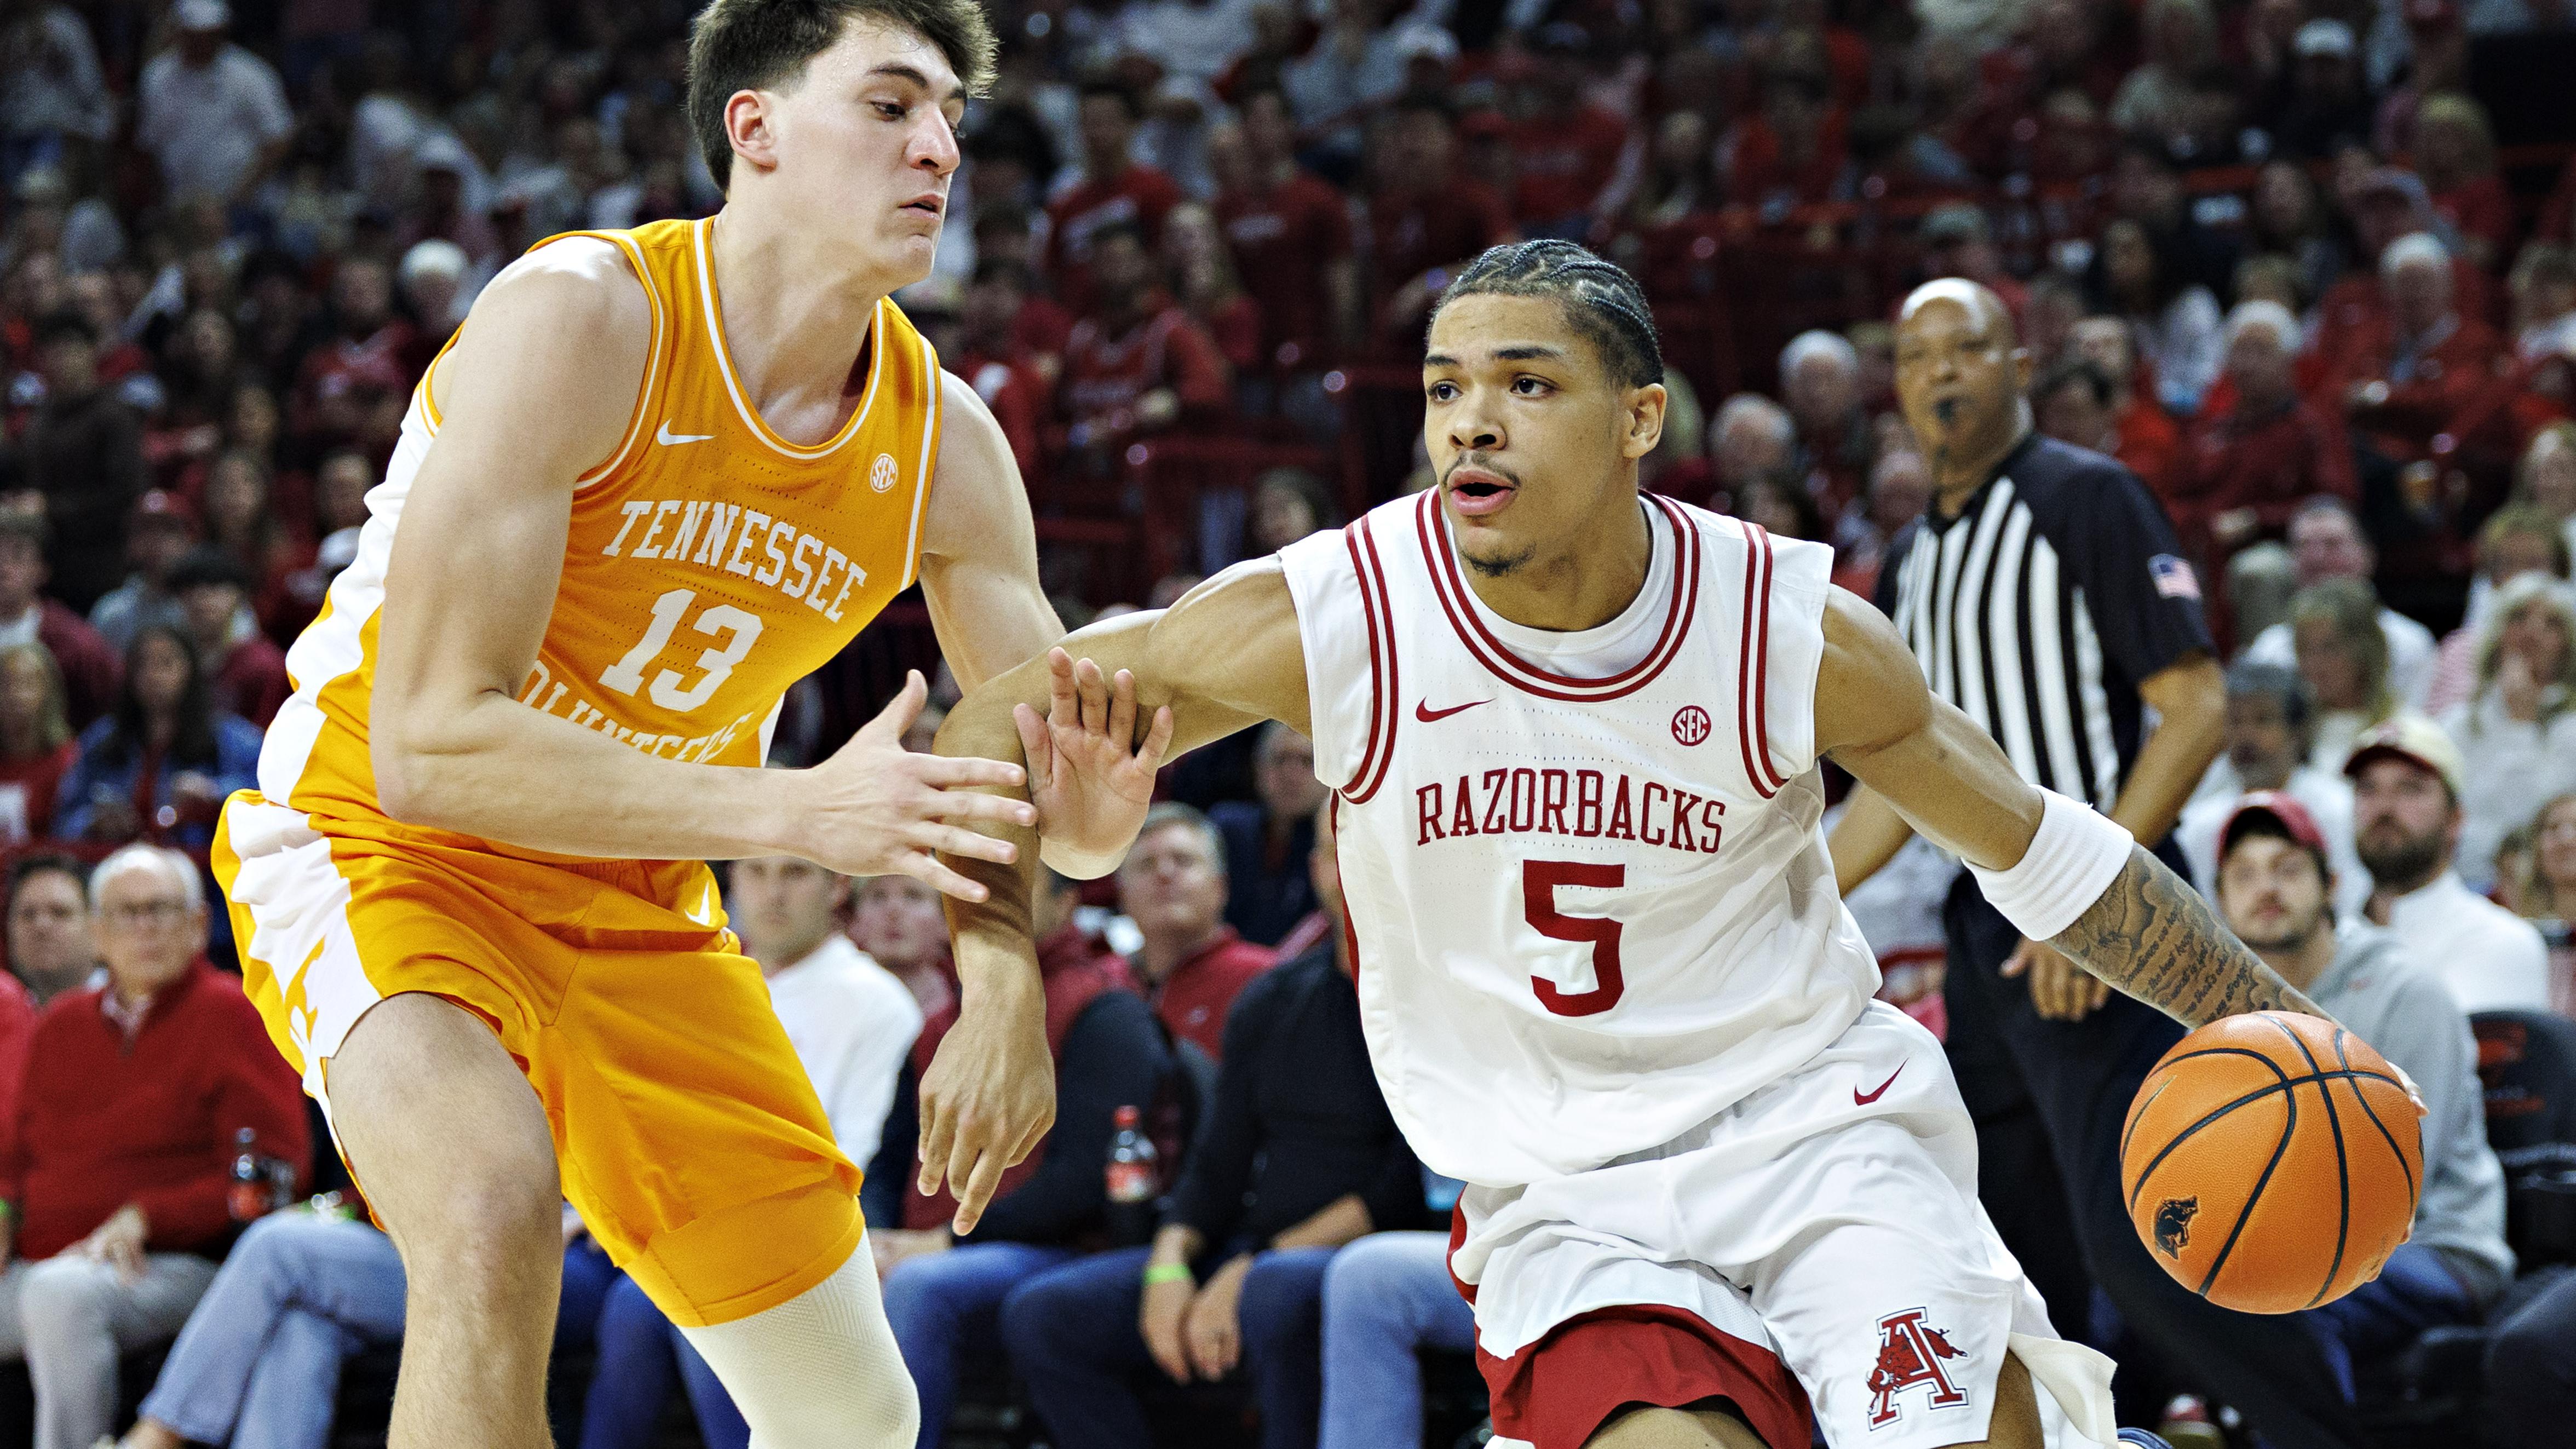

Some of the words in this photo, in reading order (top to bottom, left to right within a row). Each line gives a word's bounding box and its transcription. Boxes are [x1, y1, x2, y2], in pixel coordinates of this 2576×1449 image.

[872, 455, 896, 490] SEC
[602, 501, 867, 623] TENNESSEE
[598, 588, 764, 712] 13
[1674, 708, 1709, 744] SEC
[1416, 767, 1726, 854] RAZORBACKS
[1523, 859, 1625, 1017] 5
[2118, 941, 2159, 990] Sometimes
